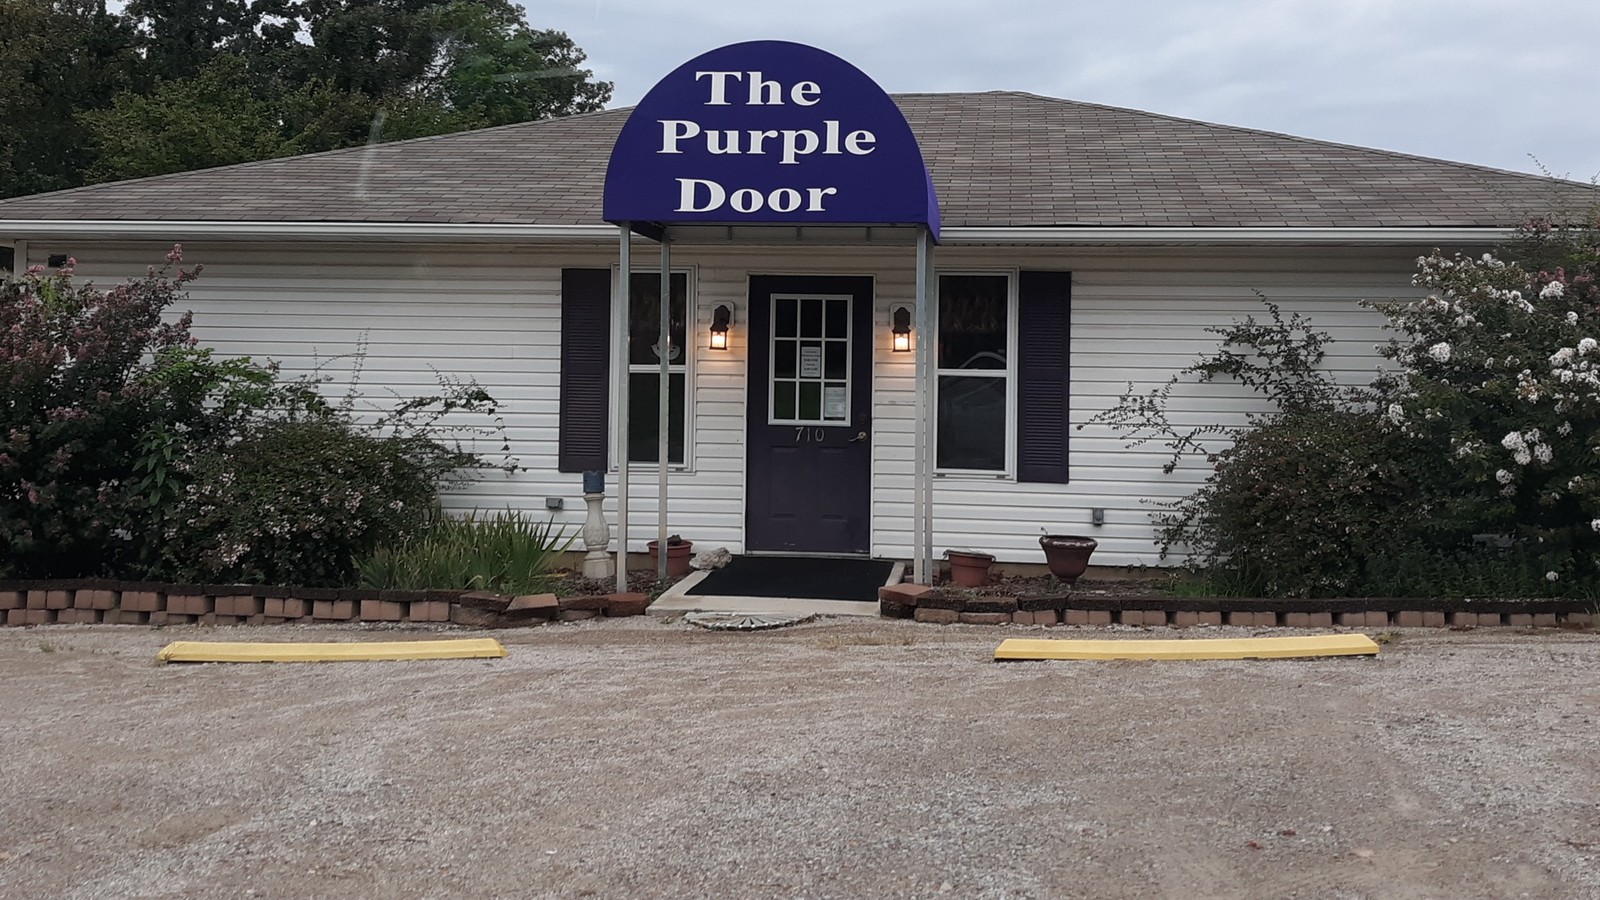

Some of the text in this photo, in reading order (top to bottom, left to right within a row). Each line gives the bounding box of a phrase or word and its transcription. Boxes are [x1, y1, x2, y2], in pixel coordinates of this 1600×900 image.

[695, 71, 821, 106] The
[656, 119, 877, 165] Purple
[673, 178, 837, 213] Door
[795, 426, 825, 442] 710
